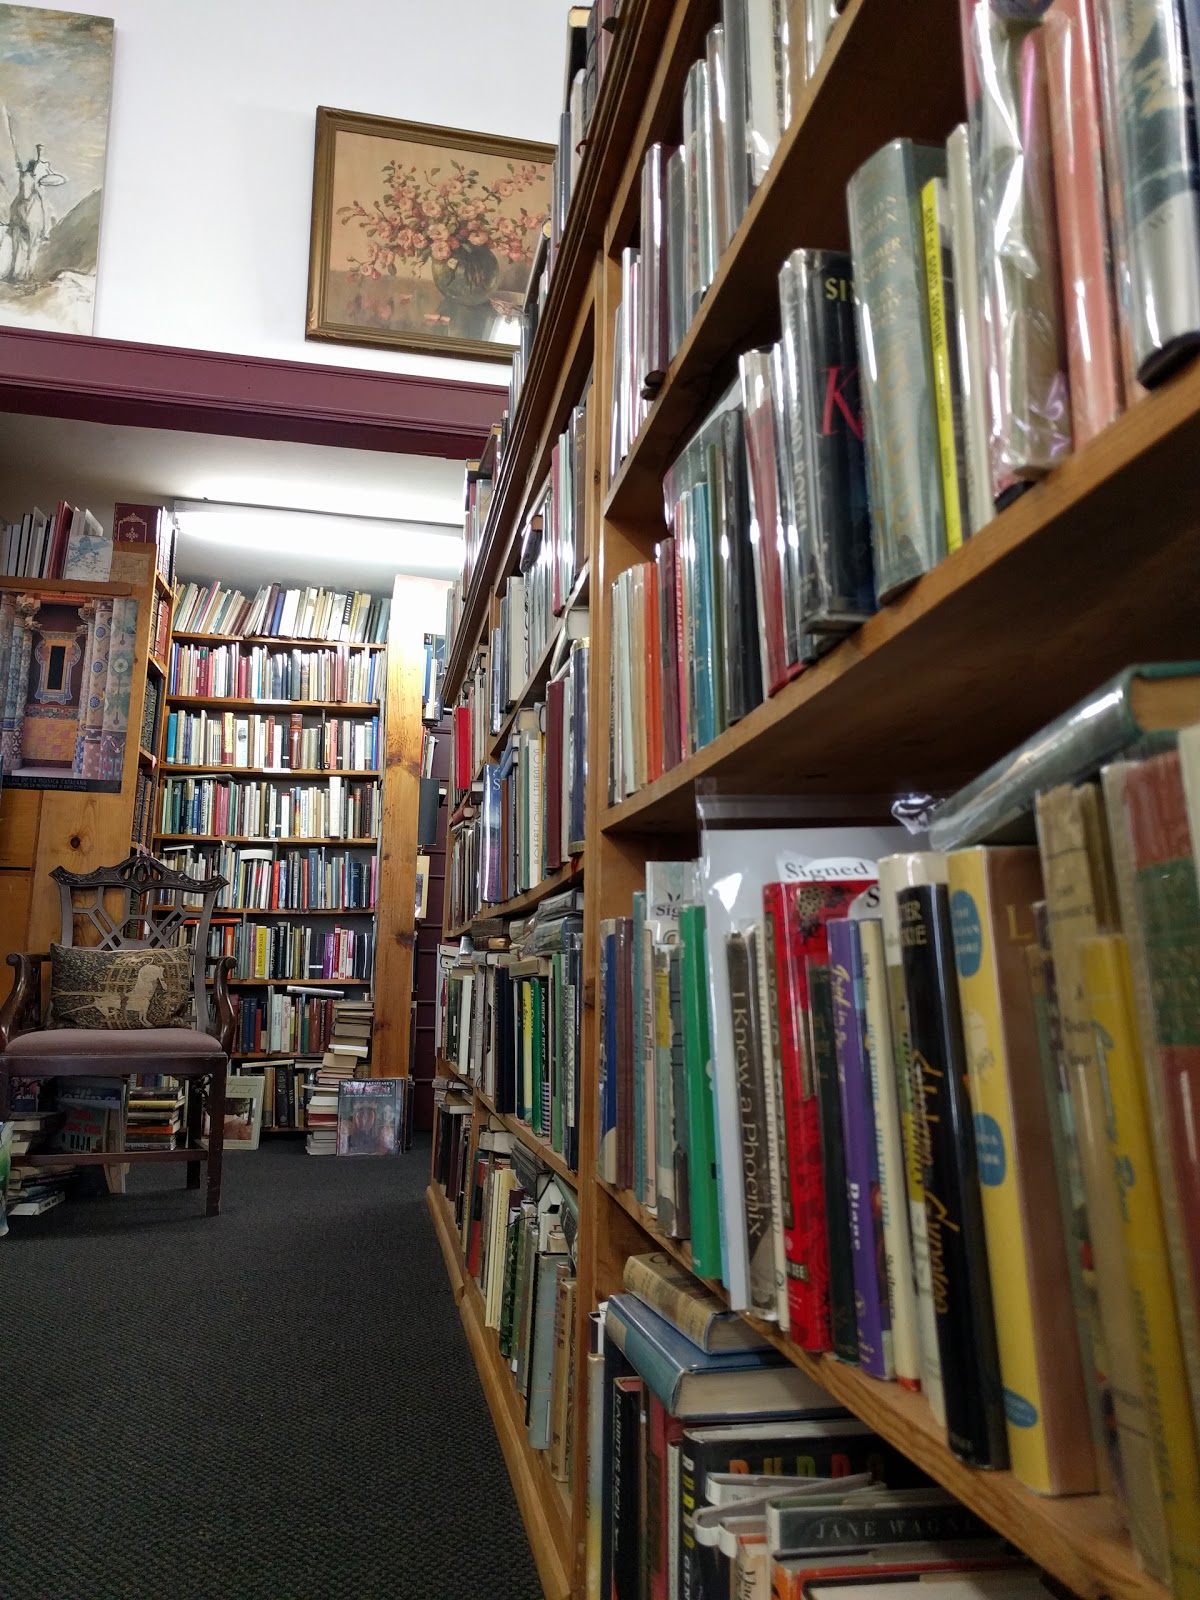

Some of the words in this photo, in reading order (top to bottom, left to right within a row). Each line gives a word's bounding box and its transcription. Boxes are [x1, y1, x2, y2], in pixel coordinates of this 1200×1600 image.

[785, 861, 869, 882] Signed
[734, 1008, 751, 1088] Knew
[741, 1097, 751, 1112] a
[742, 1123, 764, 1236] Phoenix
[816, 1519, 877, 1539] JANE
